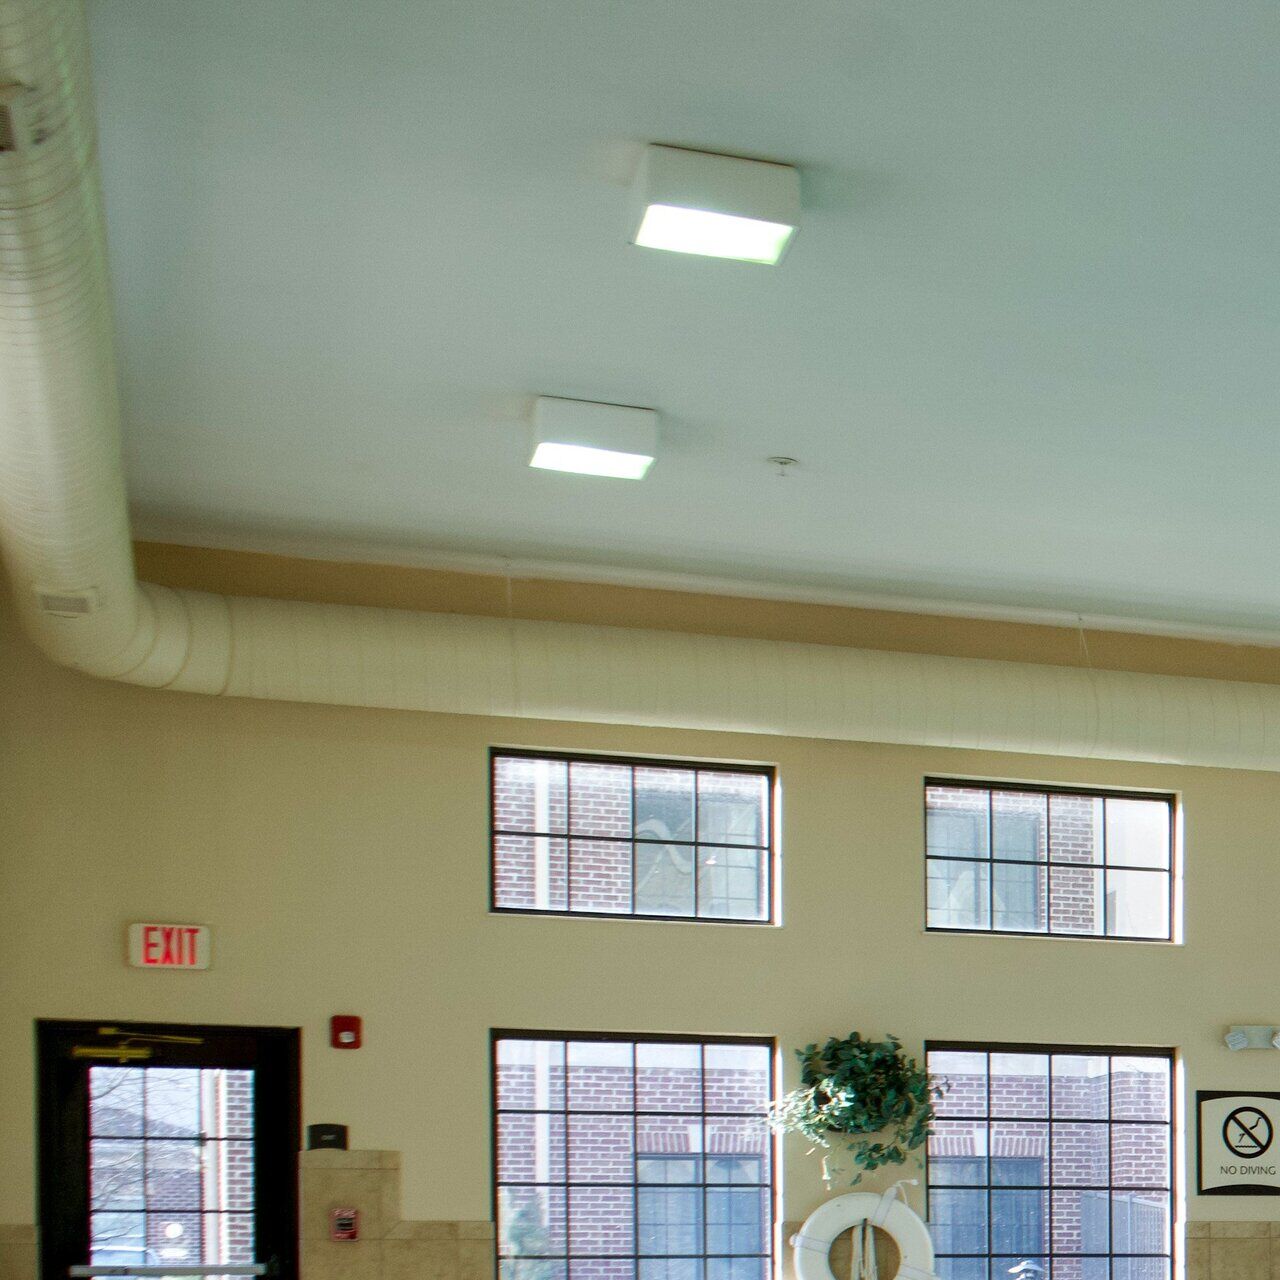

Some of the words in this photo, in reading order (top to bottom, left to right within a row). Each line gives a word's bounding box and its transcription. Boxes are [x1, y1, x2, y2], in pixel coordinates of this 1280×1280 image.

[143, 926, 200, 965] EXIT
[1220, 1165, 1237, 1175] NO
[1240, 1165, 1276, 1176] DIVING
